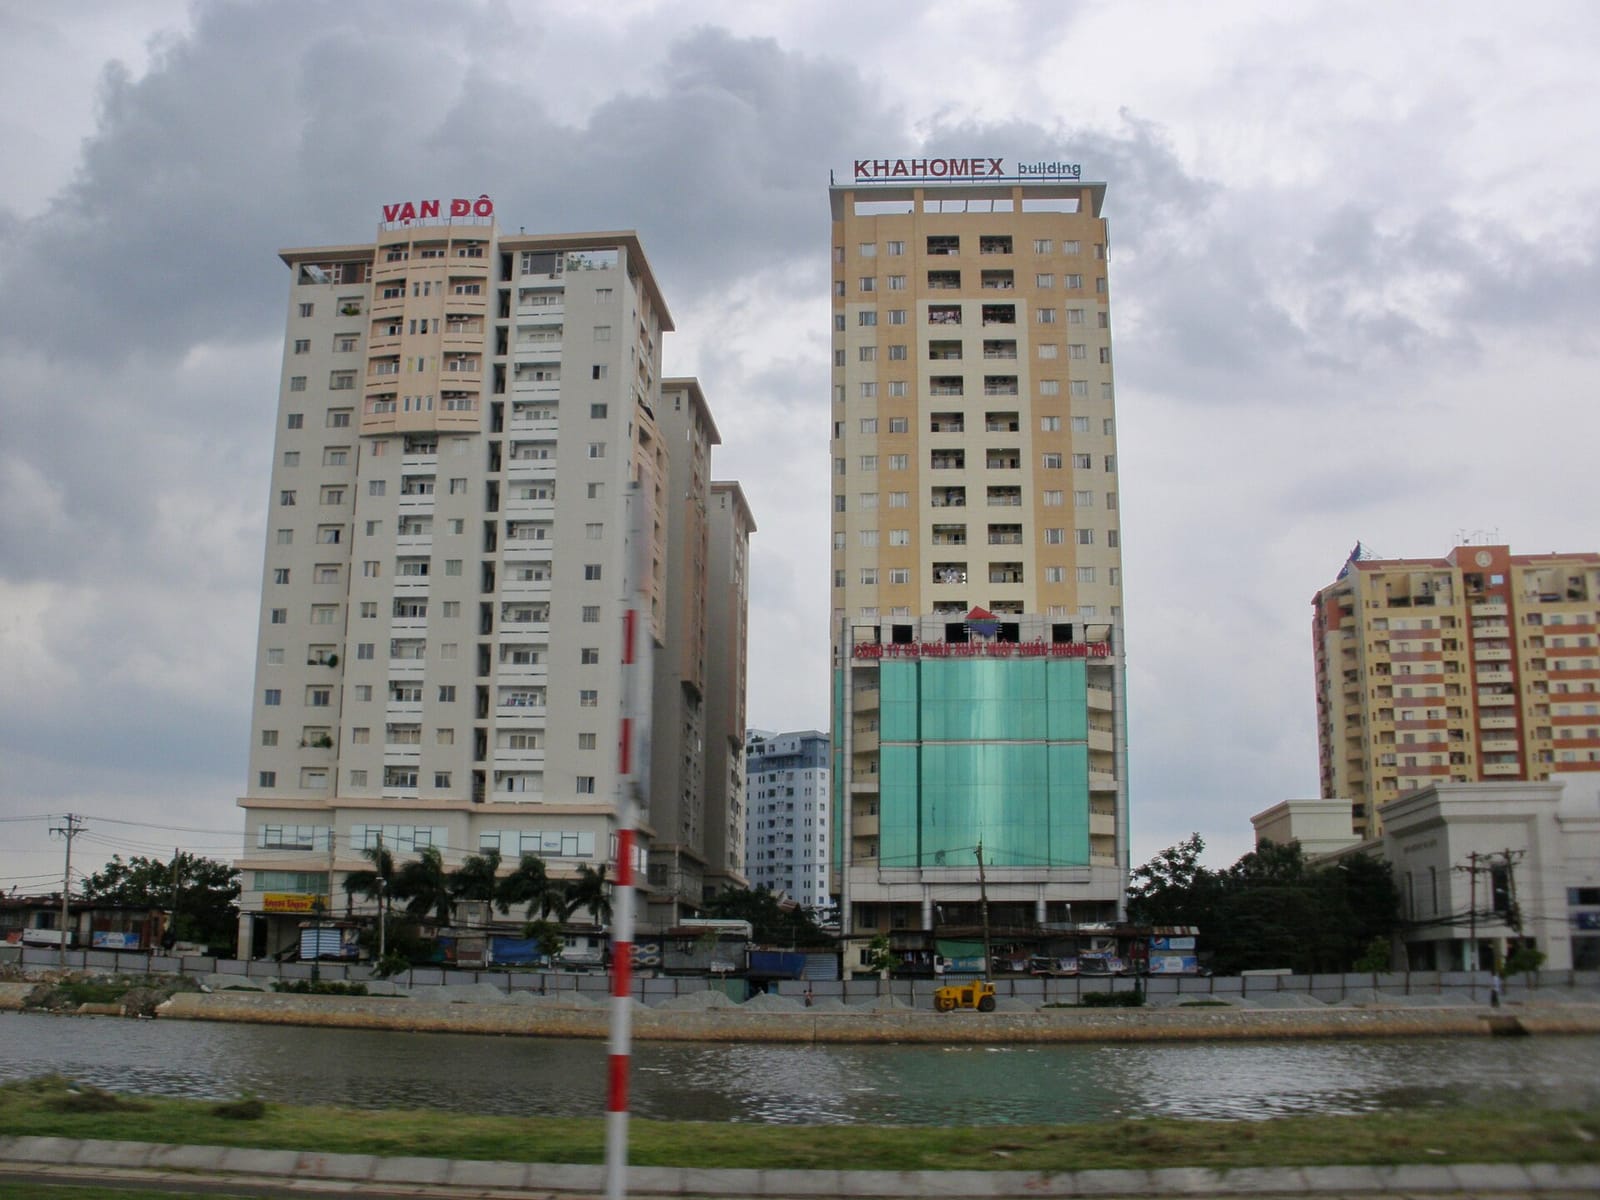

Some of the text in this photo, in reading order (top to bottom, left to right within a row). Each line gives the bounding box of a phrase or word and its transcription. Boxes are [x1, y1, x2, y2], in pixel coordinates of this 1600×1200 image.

[854, 158, 1081, 178] KHAHOMEX building
[383, 194, 494, 225] VẠN ĐÔ
[887, 643, 900, 657] TY
